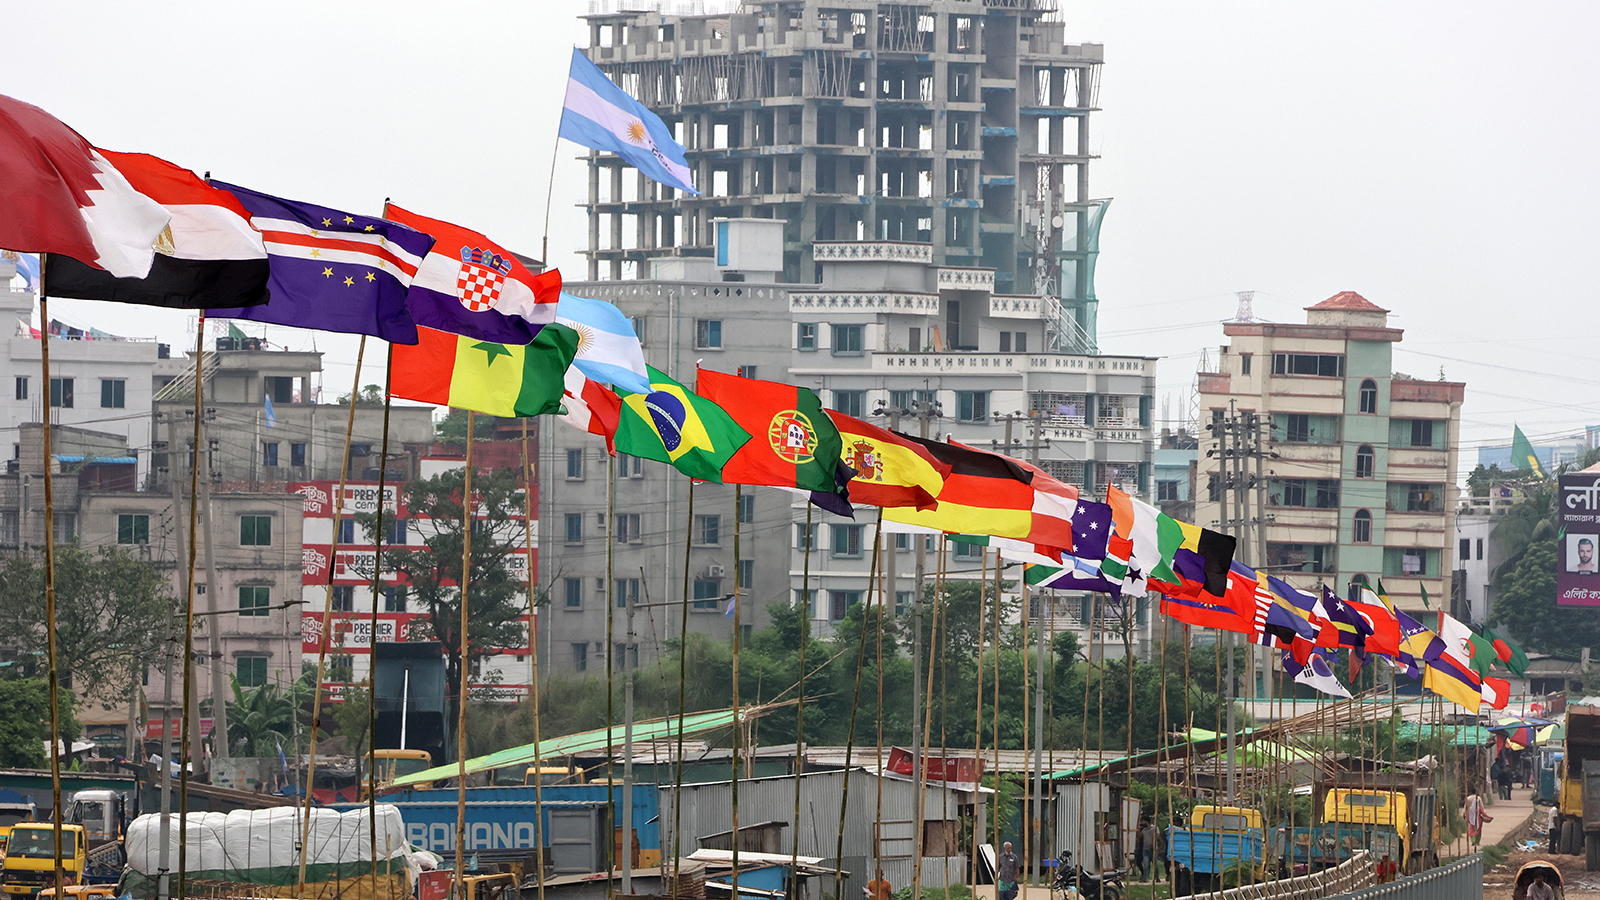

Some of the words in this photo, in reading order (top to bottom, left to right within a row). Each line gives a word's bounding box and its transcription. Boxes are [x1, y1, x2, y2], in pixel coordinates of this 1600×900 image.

[354, 489, 393, 501] PREMER
[354, 623, 393, 634] PREIER
[403, 821, 535, 851] BAHANA
